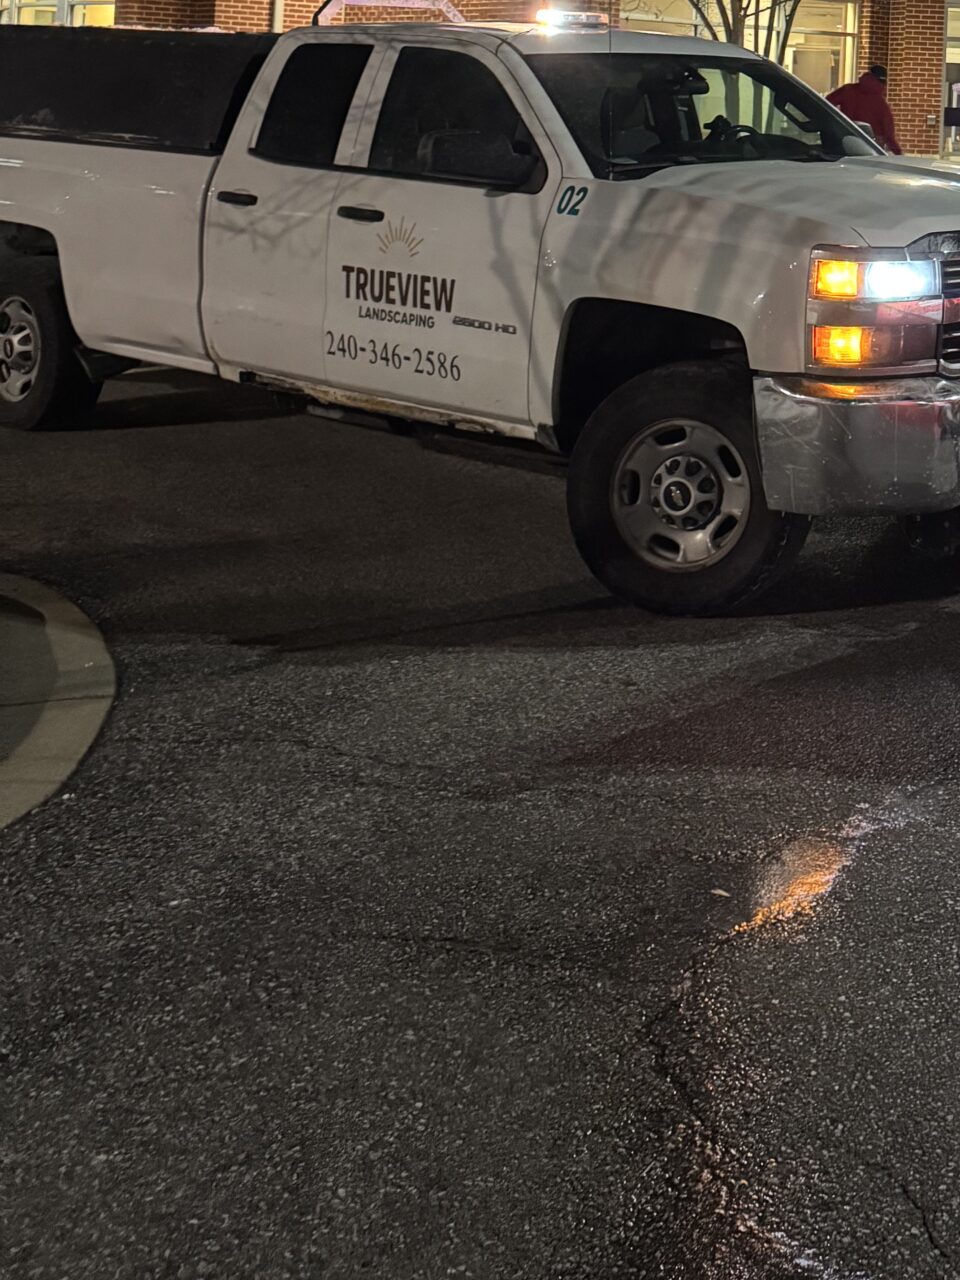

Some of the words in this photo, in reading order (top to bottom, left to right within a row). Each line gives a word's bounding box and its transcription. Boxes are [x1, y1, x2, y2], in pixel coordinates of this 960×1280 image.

[557, 185, 588, 216] 02
[342, 265, 456, 313] TRUEVIEW
[358, 306, 435, 329] LANDSCAPING
[494, 323, 517, 335] HD
[326, 331, 461, 382] 240-346-2586
